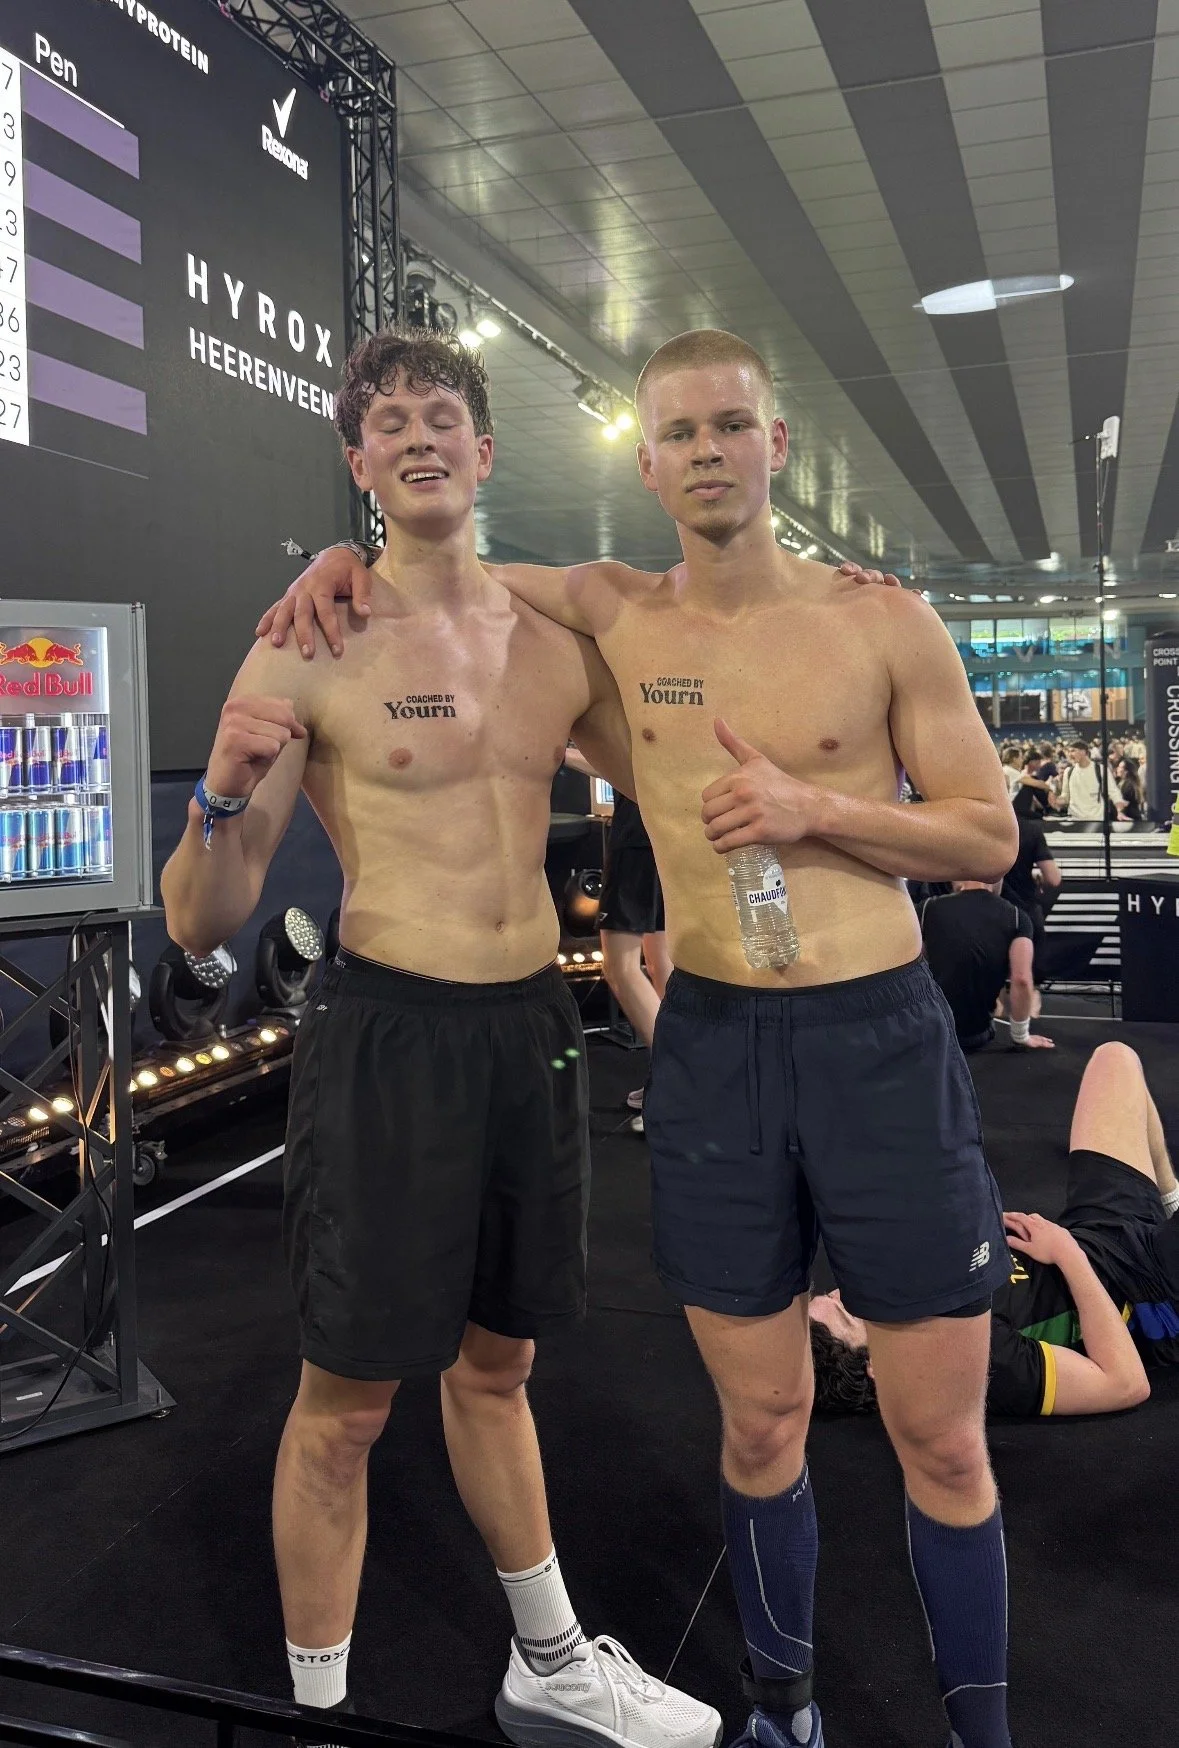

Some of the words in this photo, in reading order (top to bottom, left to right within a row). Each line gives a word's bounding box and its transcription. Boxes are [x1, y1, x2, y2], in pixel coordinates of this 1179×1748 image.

[110, 0, 209, 75] YPROTEIN
[35, 32, 78, 87] Pen
[261, 124, 309, 181] Rexona
[187, 252, 333, 369] HYROX
[189, 322, 335, 421] HEERENVEEN
[1153, 657, 1177, 666] POINT
[45, 671, 94, 697] Bull
[639, 682, 704, 706] Yourn
[656, 677, 692, 687] COACHED
[693, 678, 704, 689] BY
[383, 700, 457, 720] Yourn
[405, 694, 444, 704] COACHED
[445, 694, 455, 703] BY
[1127, 893, 1179, 918] HY
